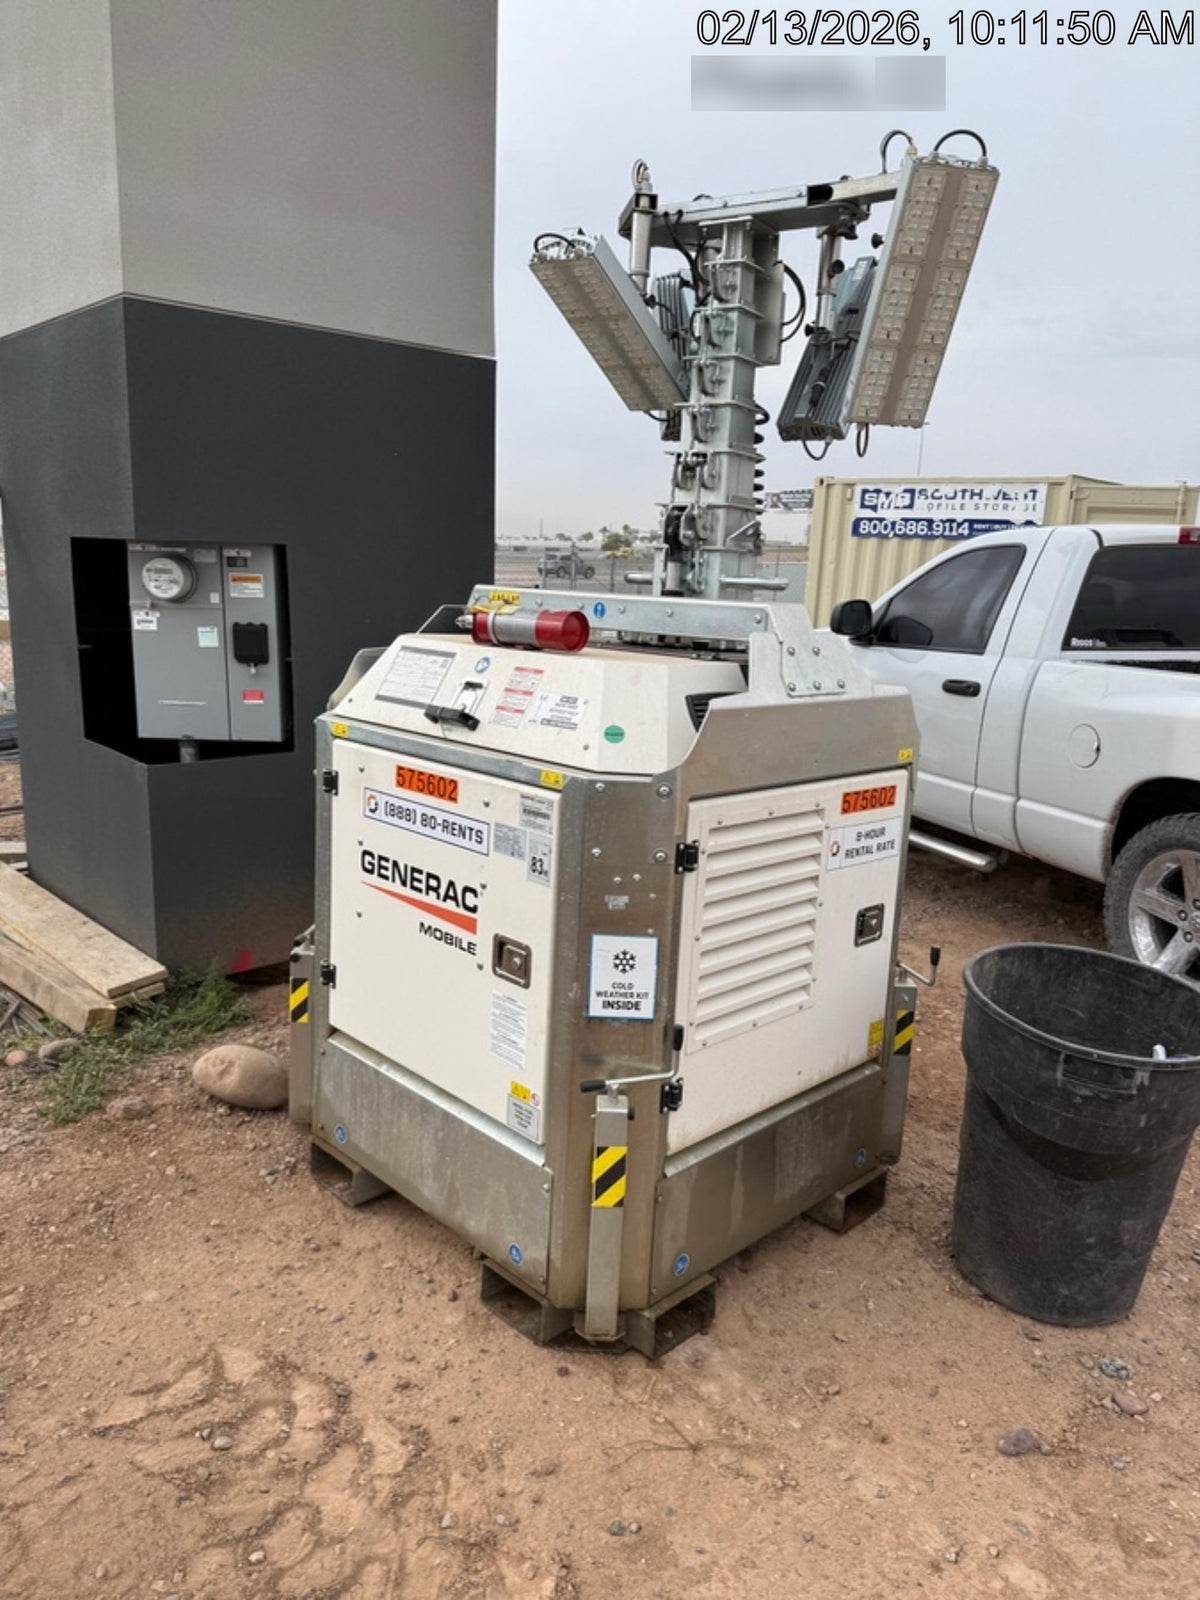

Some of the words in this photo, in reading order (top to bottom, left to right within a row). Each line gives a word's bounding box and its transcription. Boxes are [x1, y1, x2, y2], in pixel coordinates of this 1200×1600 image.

[917, 488, 1038, 501] SOUTHET
[973, 502, 1037, 513] STORE
[396, 766, 459, 803] 575602
[842, 785, 897, 813] 575602
[384, 801, 417, 825] (888)
[420, 812, 484, 846] 80-RENTS
[857, 827, 885, 841] 8-HOUR
[845, 845, 873, 859] RENTAL
[876, 839, 896, 852] RATE
[530, 856, 544, 875] 83
[360, 848, 479, 915] GENERAC
[418, 921, 478, 957] MOBILE
[595, 990, 635, 999] WEATHER
[636, 991, 650, 999] KIT
[611, 982, 634, 990] COLD
[602, 1000, 642, 1011] INSIDE
